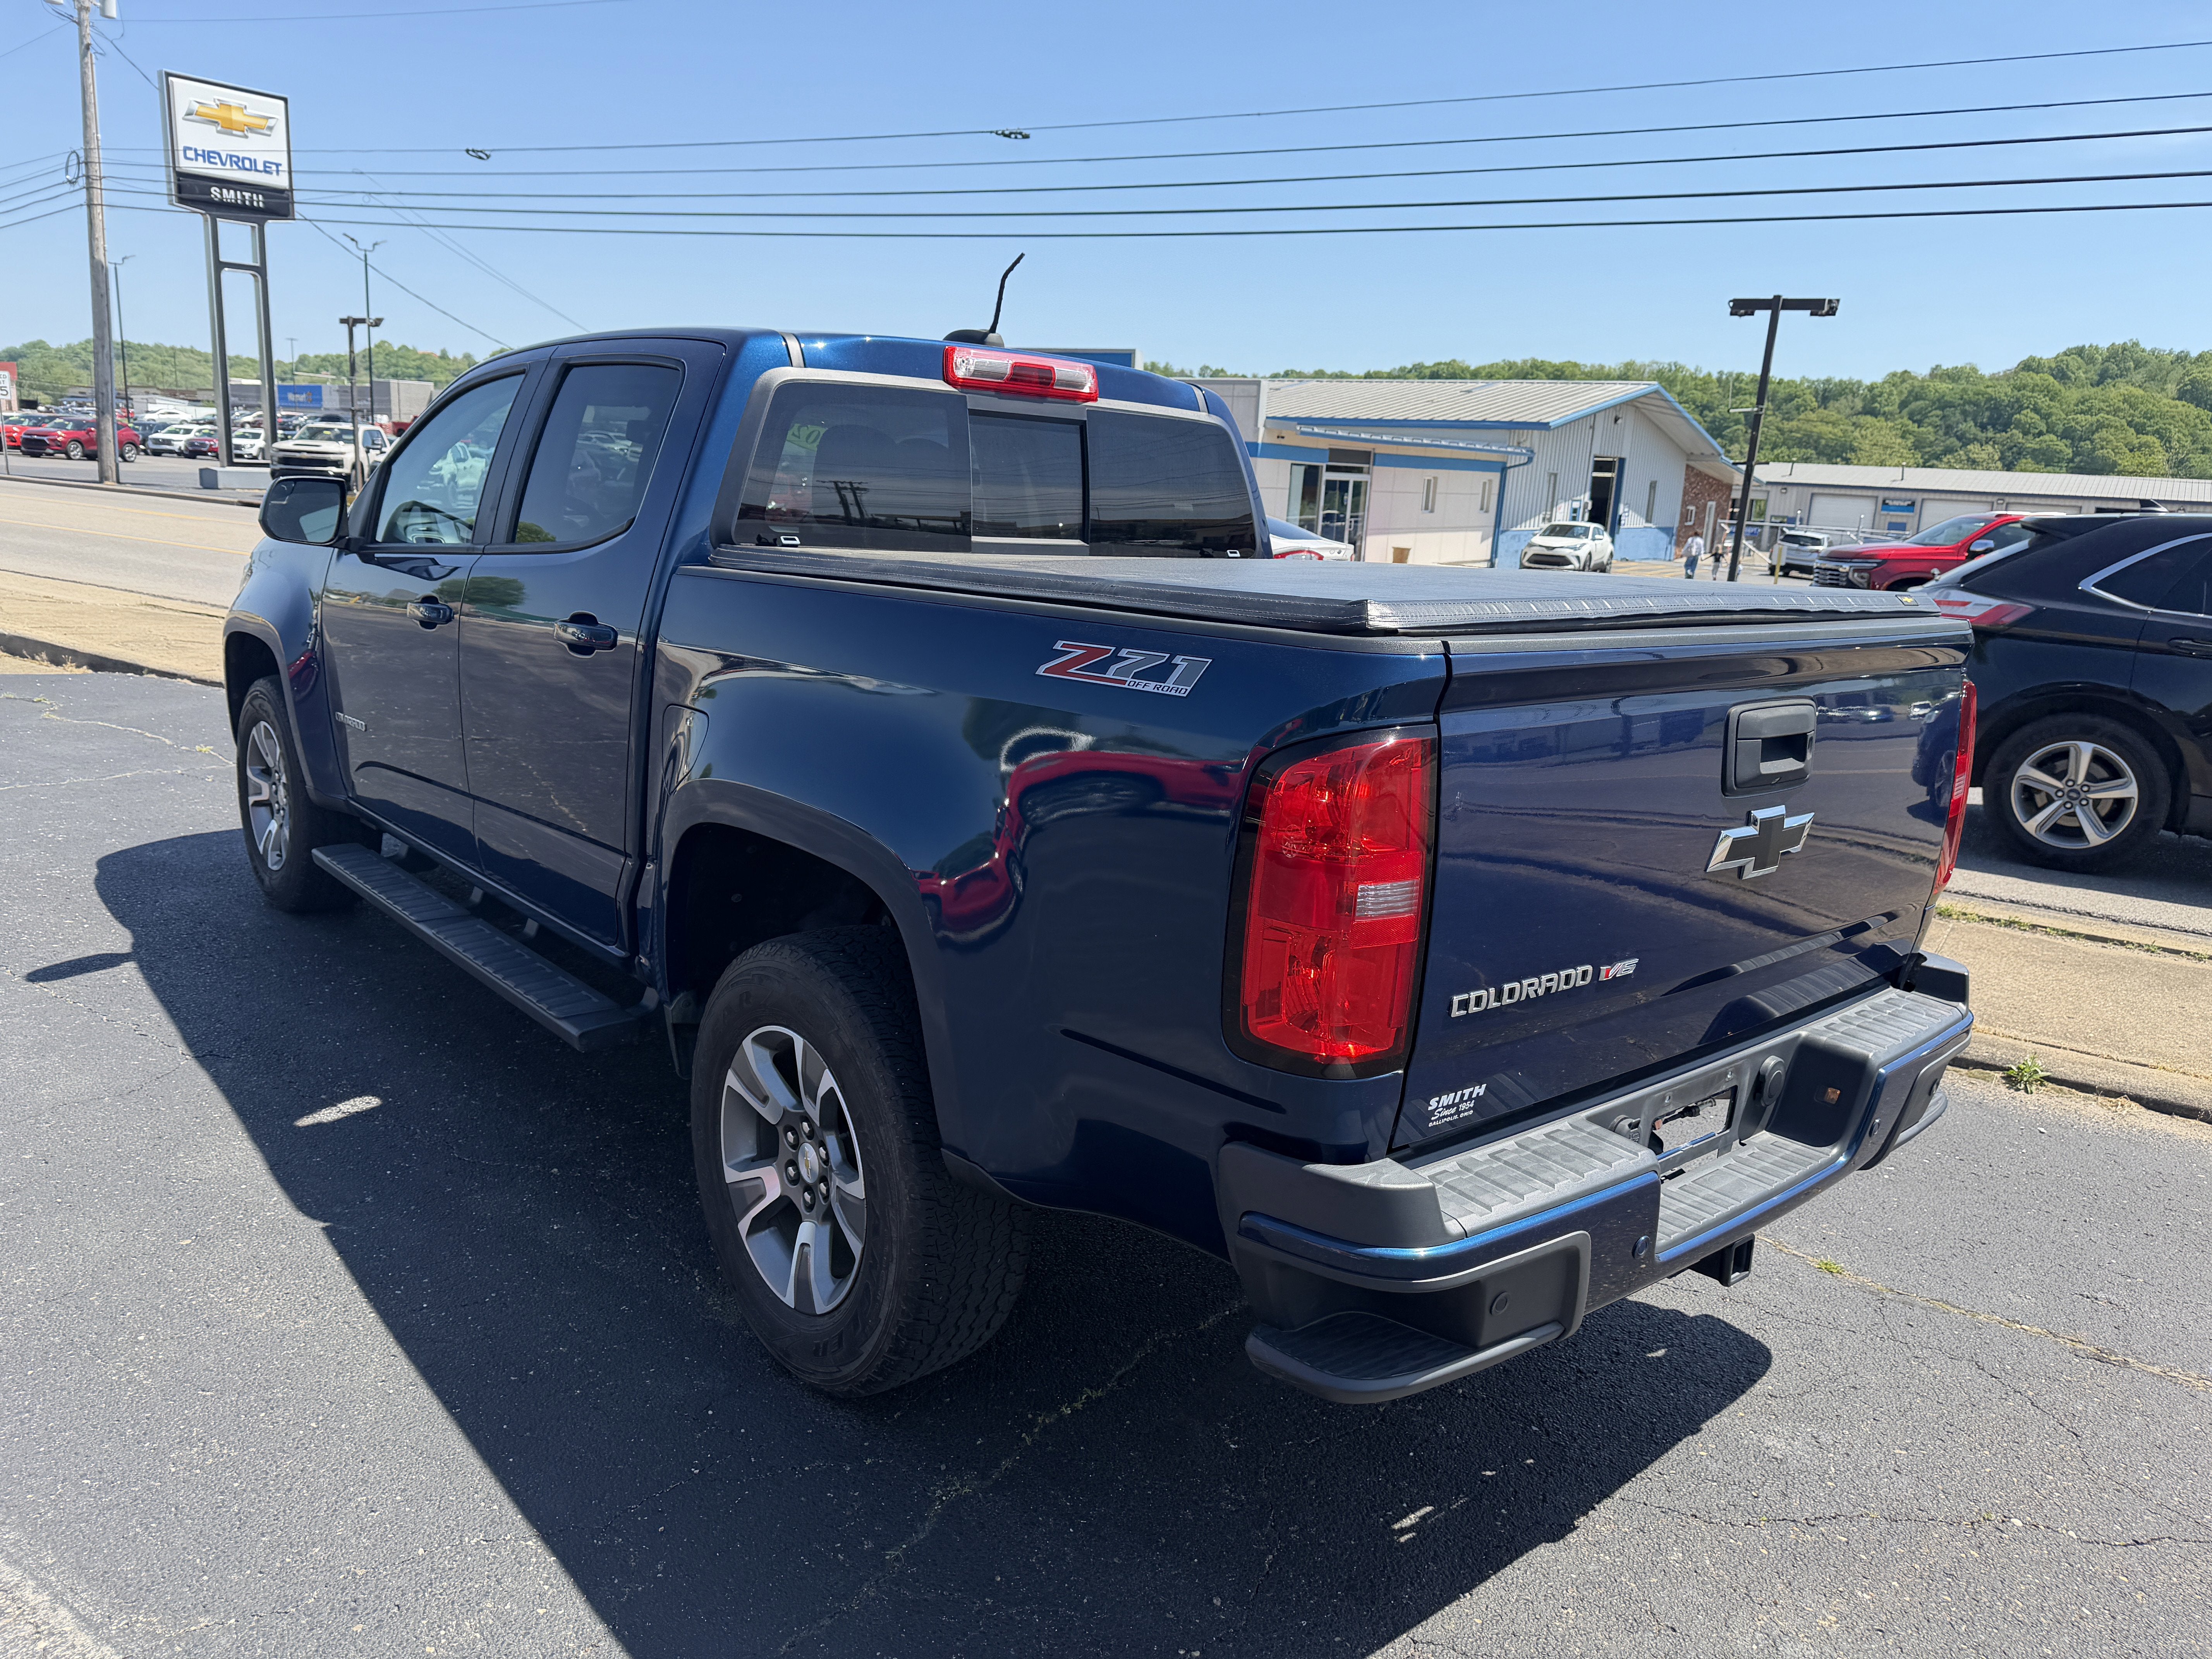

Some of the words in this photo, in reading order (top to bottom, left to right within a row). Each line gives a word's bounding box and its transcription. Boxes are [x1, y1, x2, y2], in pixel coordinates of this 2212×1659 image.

[183, 146, 282, 176] CHEVROLET
[211, 187, 265, 208] SMITH
[0, 386, 8, 396] 5
[1036, 640, 1212, 692] Z71
[1127, 680, 1151, 689] OFF
[1153, 684, 1188, 694] ROAD
[1449, 965, 1593, 1018] COLORADO
[1599, 958, 1639, 981] V6
[1428, 1084, 1487, 1110] SMITH
[1431, 1107, 1457, 1120] Since
[1459, 1100, 1475, 1111] 1954
